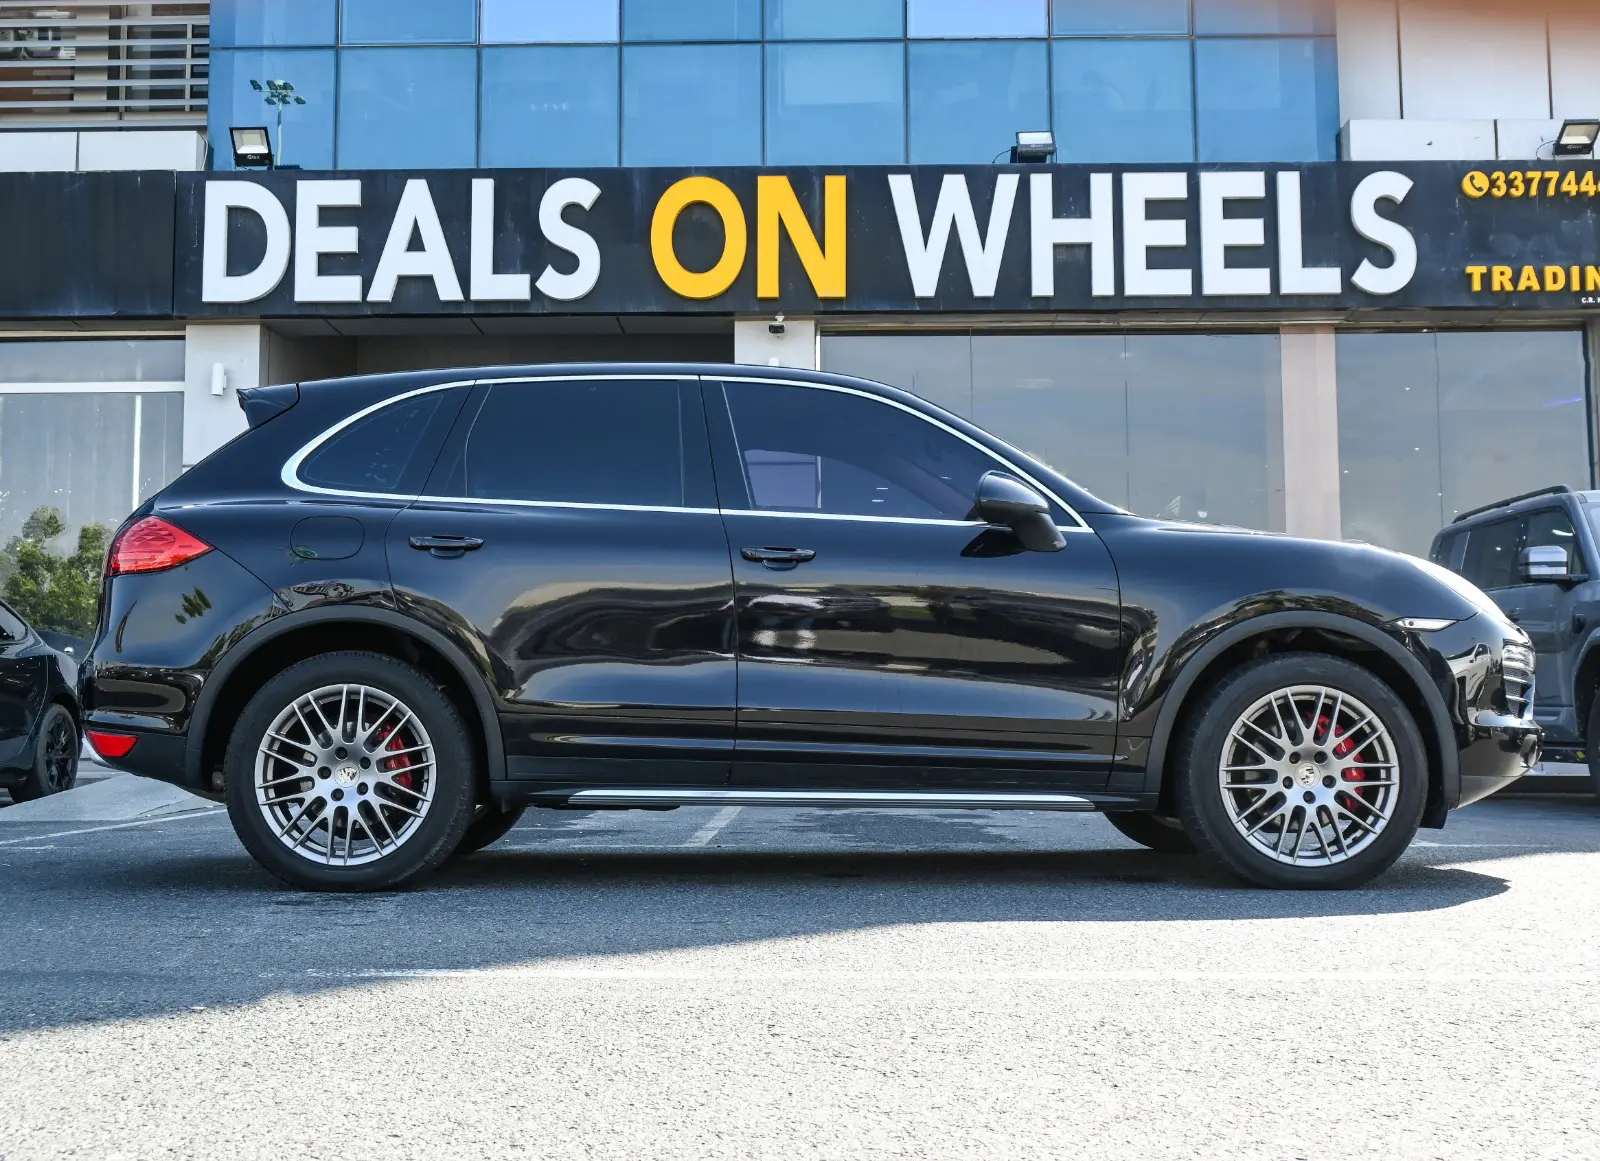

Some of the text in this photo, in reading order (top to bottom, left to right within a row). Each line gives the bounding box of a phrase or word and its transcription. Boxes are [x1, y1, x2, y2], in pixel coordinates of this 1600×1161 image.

[1490, 170, 1600, 198] 337744
[201, 170, 1418, 304] DEALS ON WHEELS
